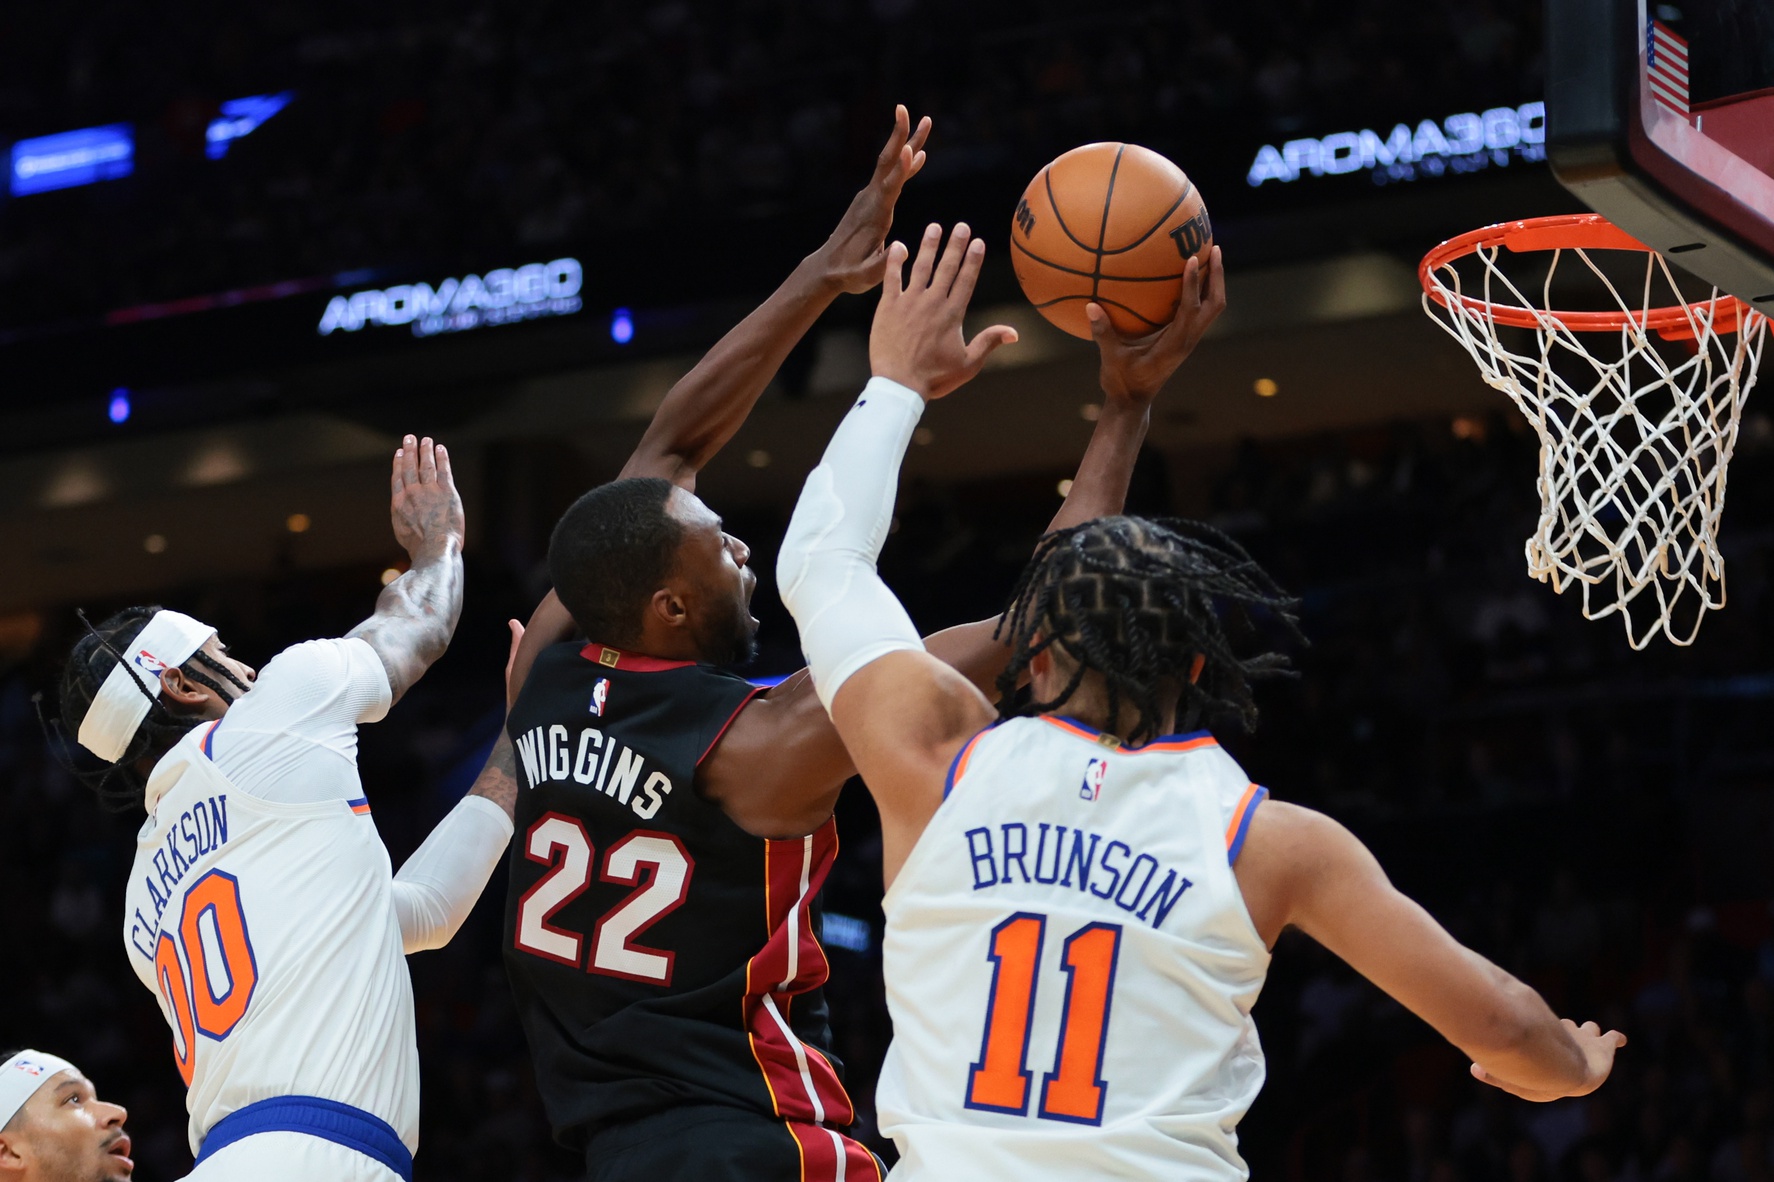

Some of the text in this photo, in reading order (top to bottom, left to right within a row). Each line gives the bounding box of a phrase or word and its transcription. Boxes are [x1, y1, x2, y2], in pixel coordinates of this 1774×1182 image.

[318, 257, 583, 336] AROMA360
[516, 725, 672, 820] WIGGINS
[132, 795, 237, 962] CLARKSON
[514, 811, 695, 987] 22
[965, 823, 1193, 929] BRUNSON
[155, 867, 258, 1089] 00
[964, 911, 1122, 1127] 11
